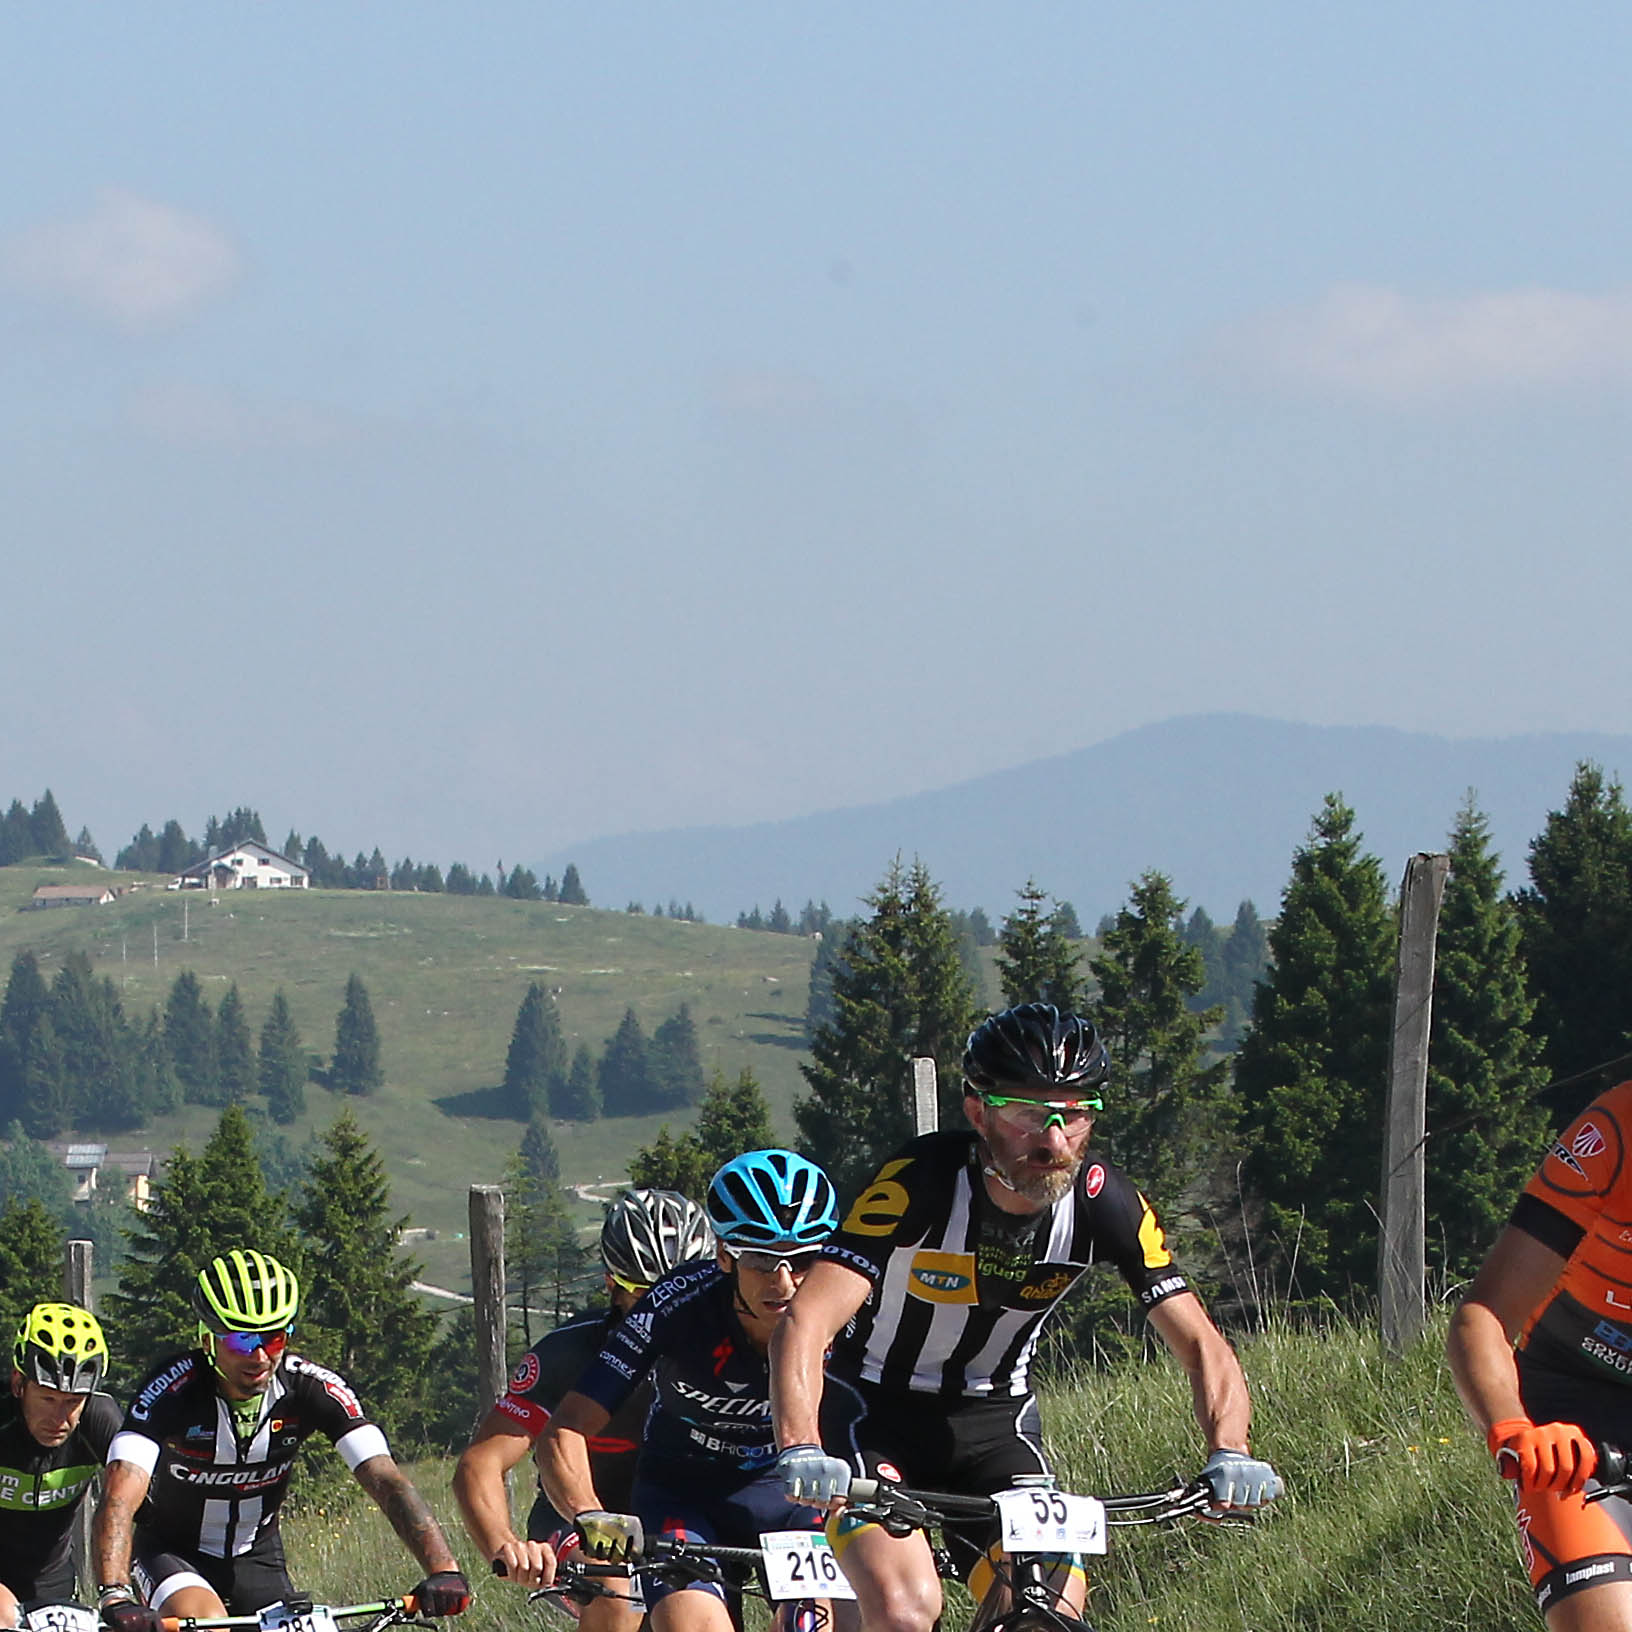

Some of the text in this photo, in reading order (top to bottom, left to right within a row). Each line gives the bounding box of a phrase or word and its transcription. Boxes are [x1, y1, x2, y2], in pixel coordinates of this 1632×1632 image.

[819, 1244, 881, 1280] OTOR
[647, 1275, 688, 1308] ZERO
[919, 1272, 960, 1289] MTN
[625, 1317, 652, 1344] adidas
[1030, 1492, 1068, 1525] 55
[787, 1551, 837, 1582] 216
